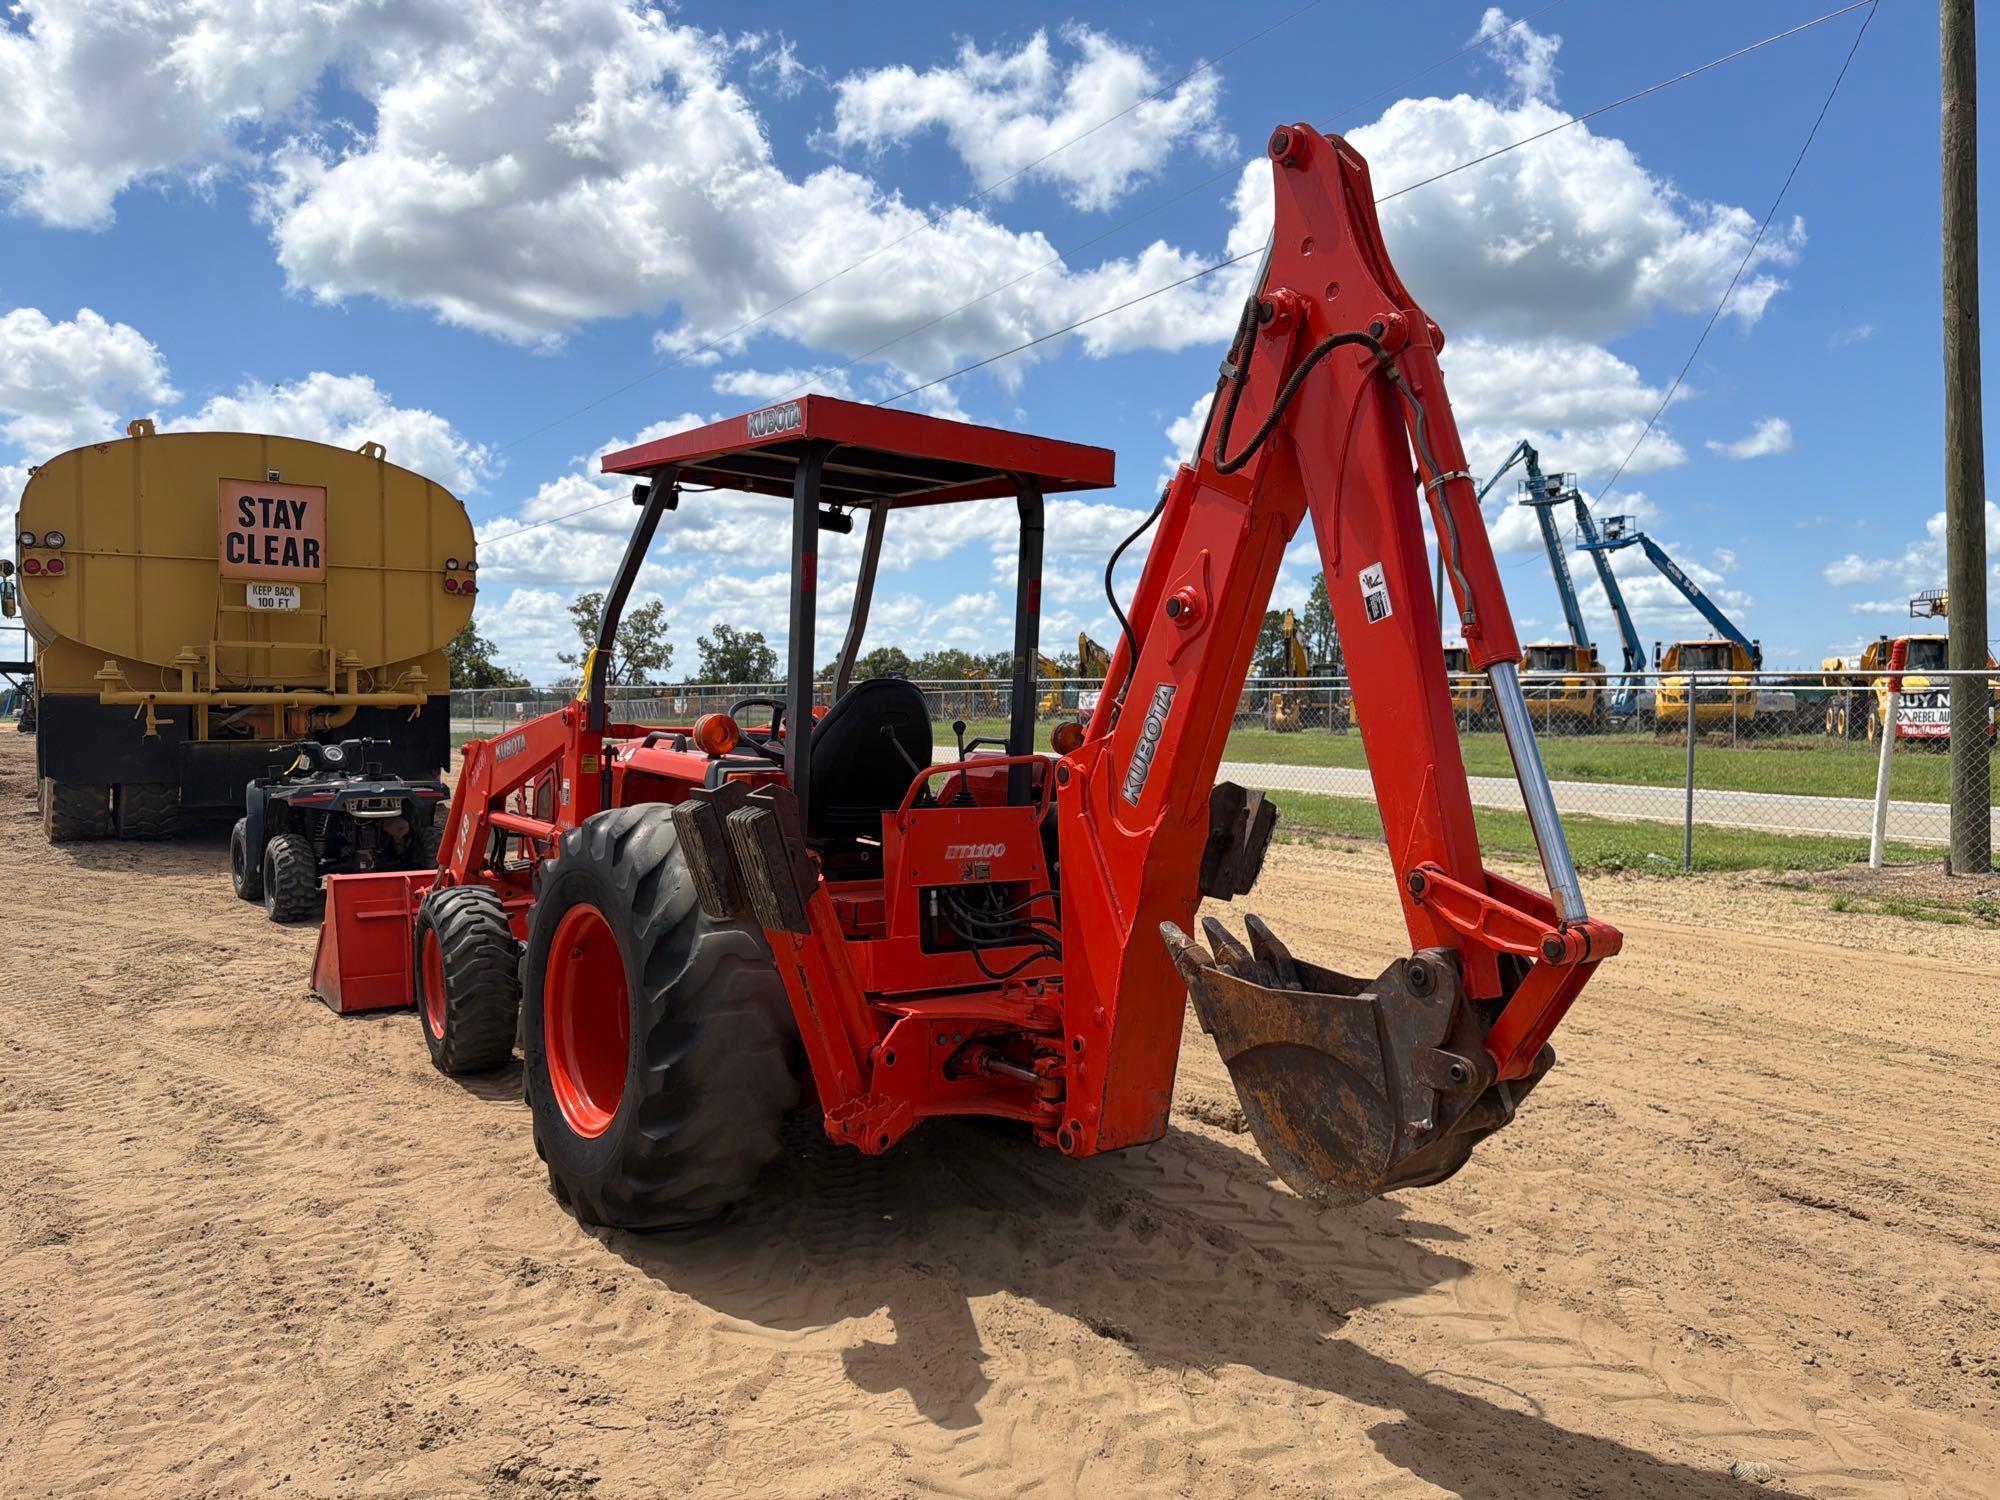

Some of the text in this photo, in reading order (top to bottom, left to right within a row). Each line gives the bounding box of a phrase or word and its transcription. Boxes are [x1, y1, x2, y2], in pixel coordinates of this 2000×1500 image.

[748, 402, 801, 438] KUBOTA
[238, 495, 307, 530] STAY
[226, 531, 320, 568] CLEAR
[252, 585, 295, 597] KEEP BACK
[258, 597, 290, 608] 100 FT
[1912, 711, 1936, 723] REBEL
[496, 734, 527, 761] KUBOTA
[1121, 684, 1177, 806] KUBOTA
